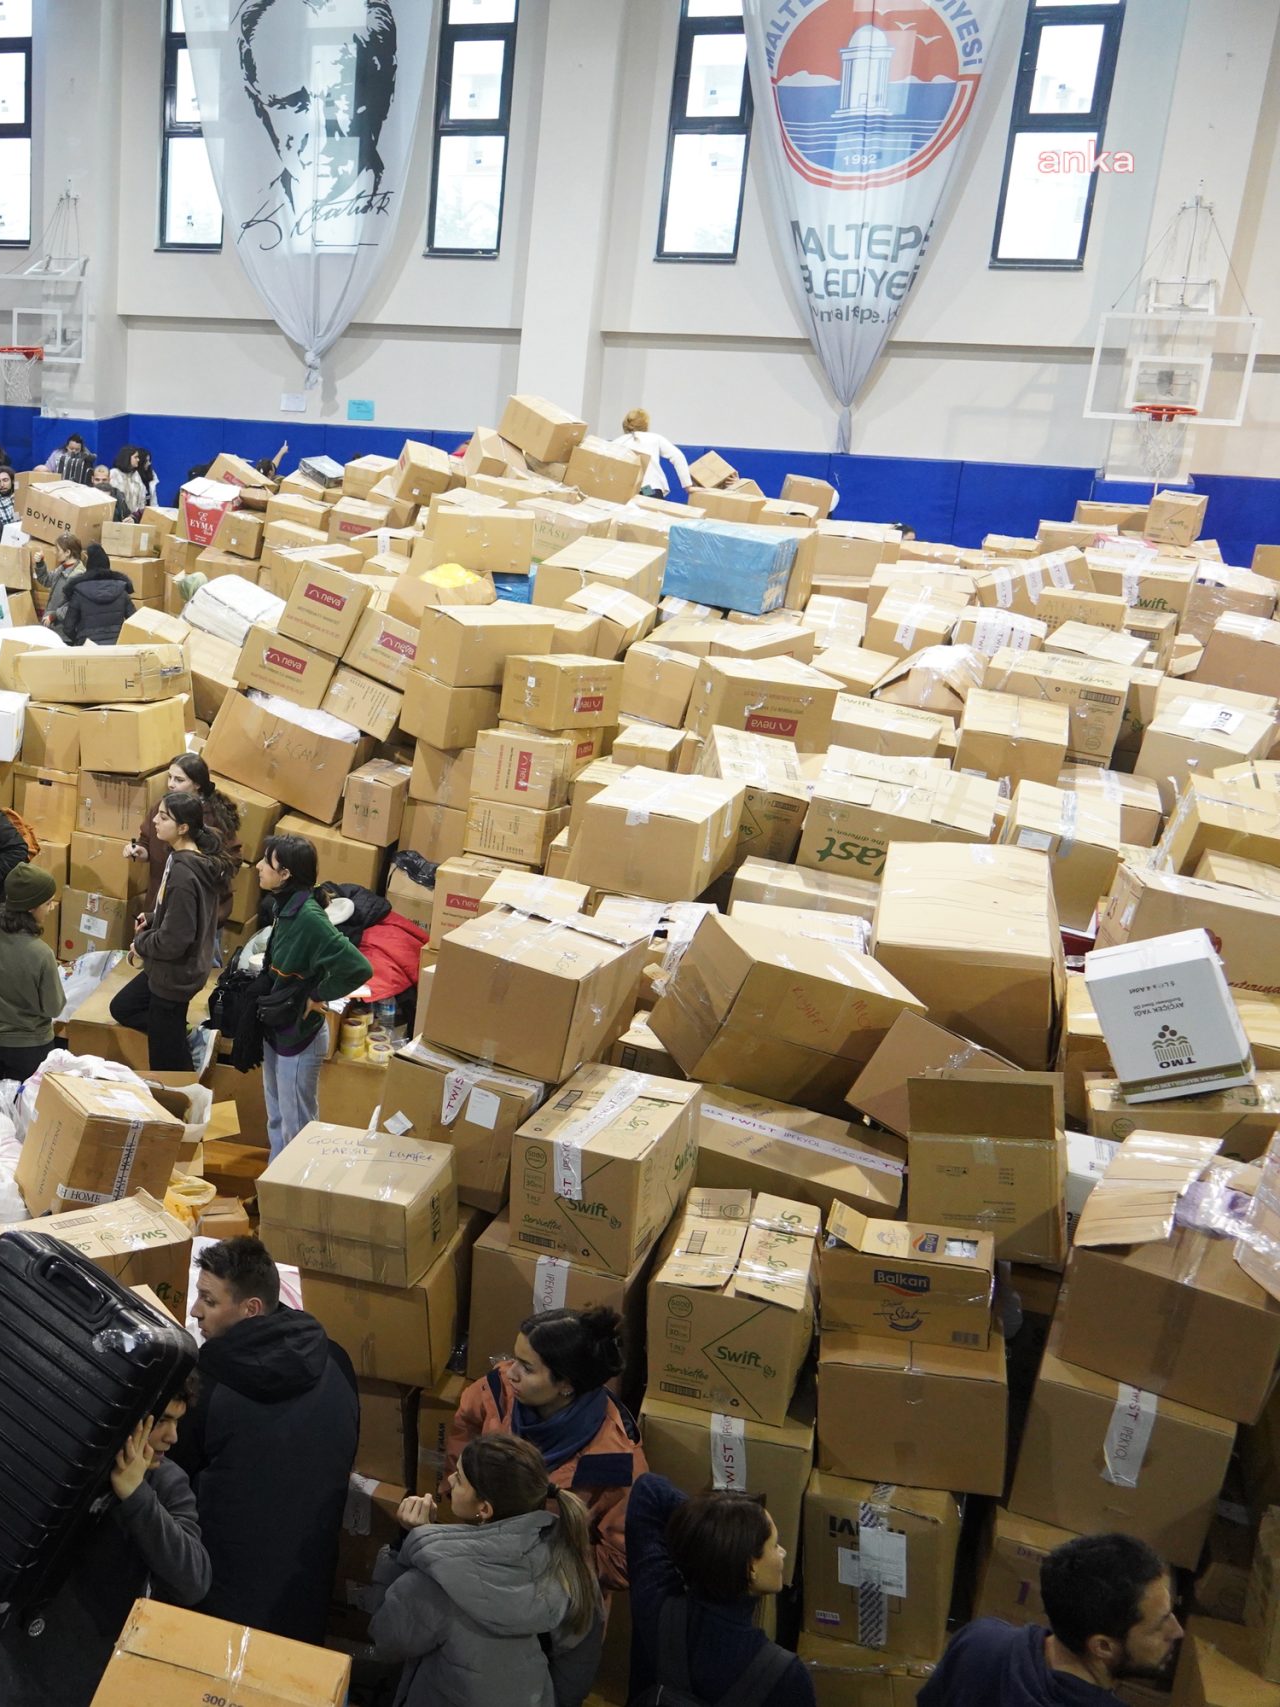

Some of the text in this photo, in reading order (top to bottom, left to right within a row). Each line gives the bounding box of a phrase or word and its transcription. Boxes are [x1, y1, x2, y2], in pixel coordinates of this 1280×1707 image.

[843, 154, 877, 166] 1992
[26, 506, 71, 532] BOYNER
[189, 519, 215, 532] EYMA
[320, 592, 342, 608] neva
[393, 640, 415, 656] neva
[281, 656, 303, 671] neva
[751, 719, 776, 730] neva
[826, 827, 868, 844] differene
[1159, 1056, 1197, 1069] TMO
[731, 1115, 777, 1133] TWIST
[71, 1190, 102, 1203] HOME
[877, 1271, 928, 1288] Balkan
[716, 1346, 762, 1368] Swift
